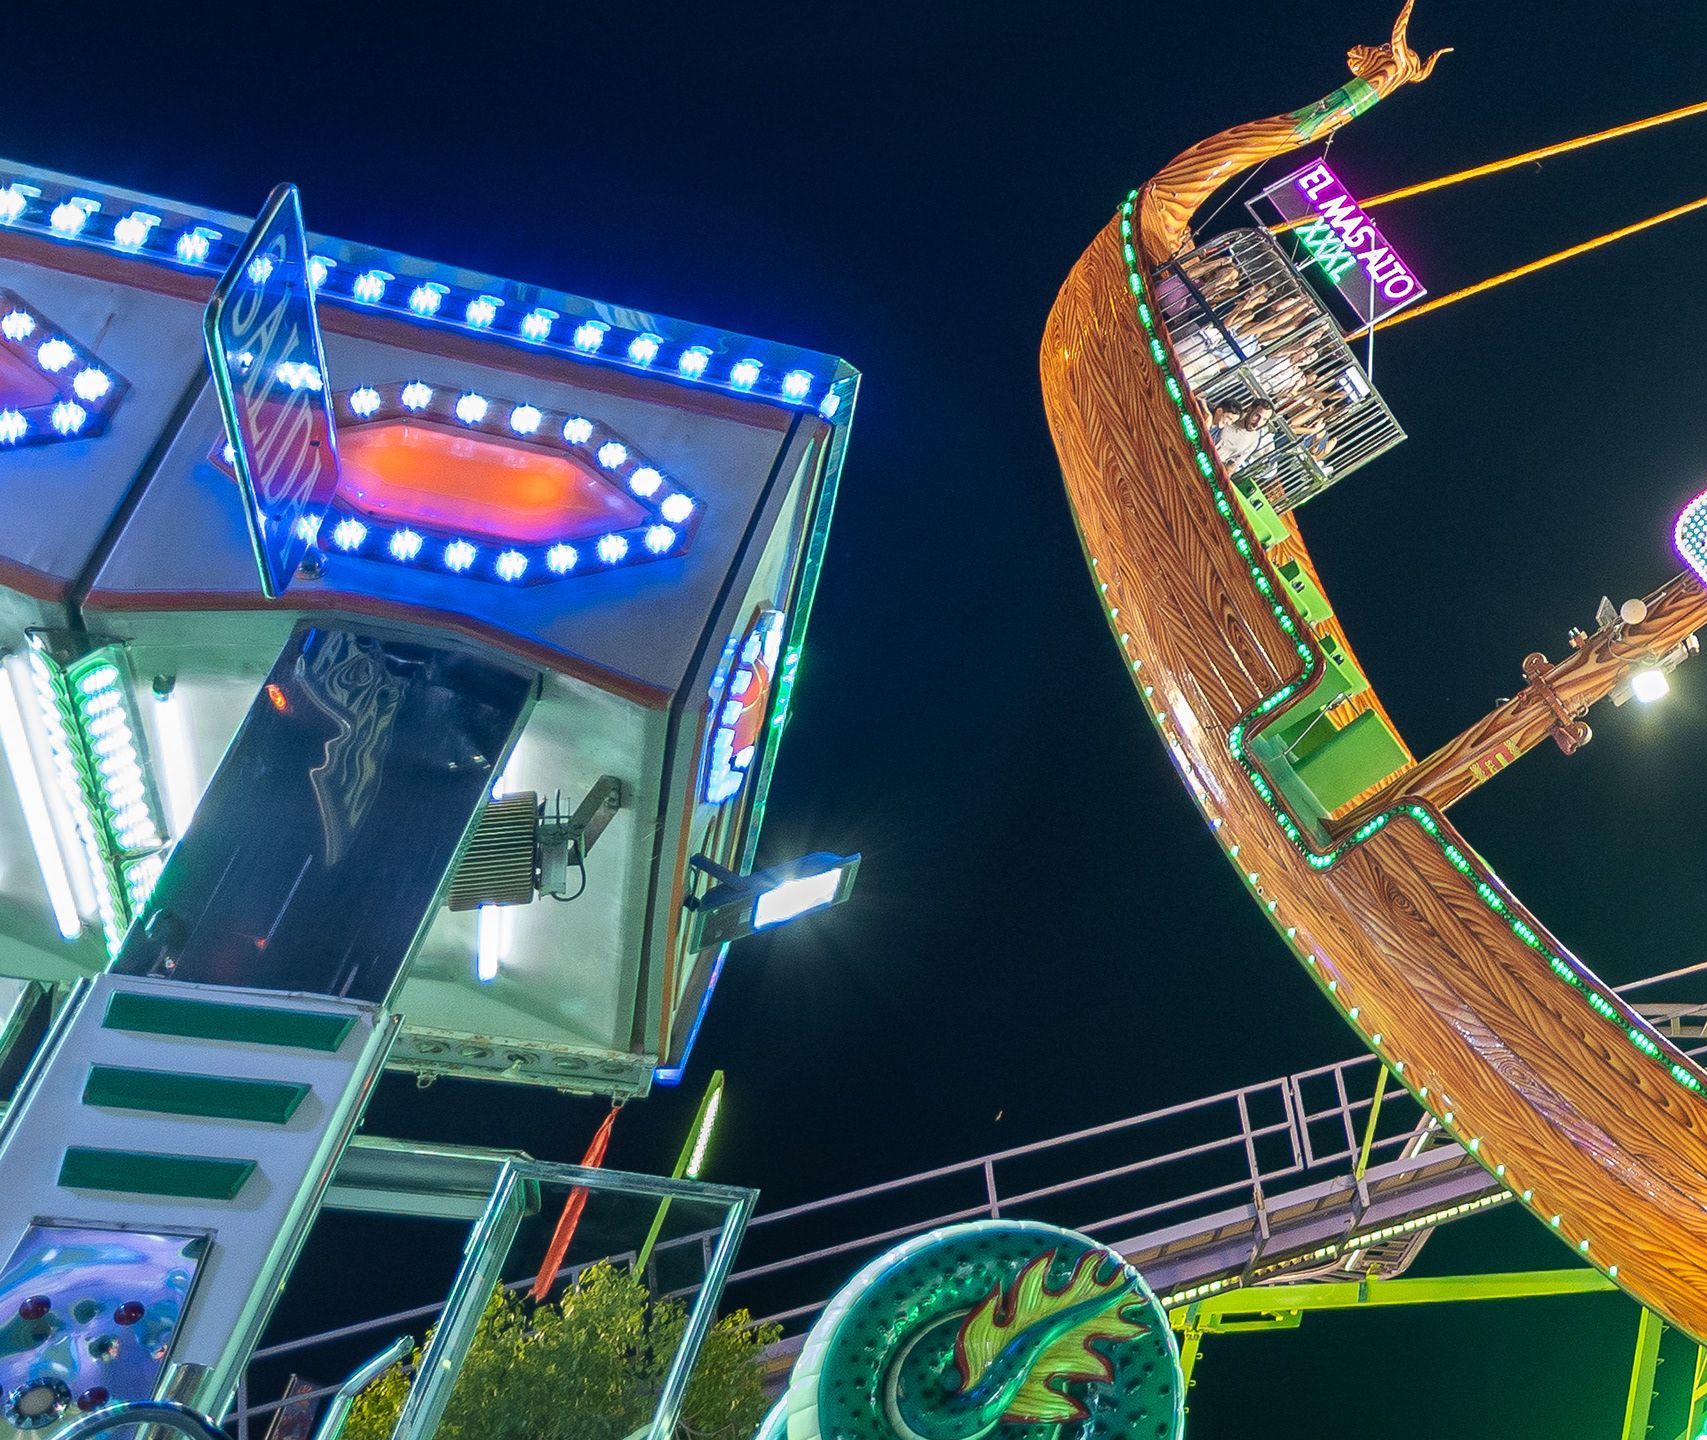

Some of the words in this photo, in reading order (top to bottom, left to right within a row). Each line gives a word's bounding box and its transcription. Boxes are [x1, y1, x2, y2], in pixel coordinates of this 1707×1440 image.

[1294, 215, 1357, 284] XXXL
[1298, 164, 1335, 201] EL
[1318, 194, 1376, 248] MAS
[1356, 246, 1415, 299] ALTO
[231, 233, 323, 572] SALIDA
